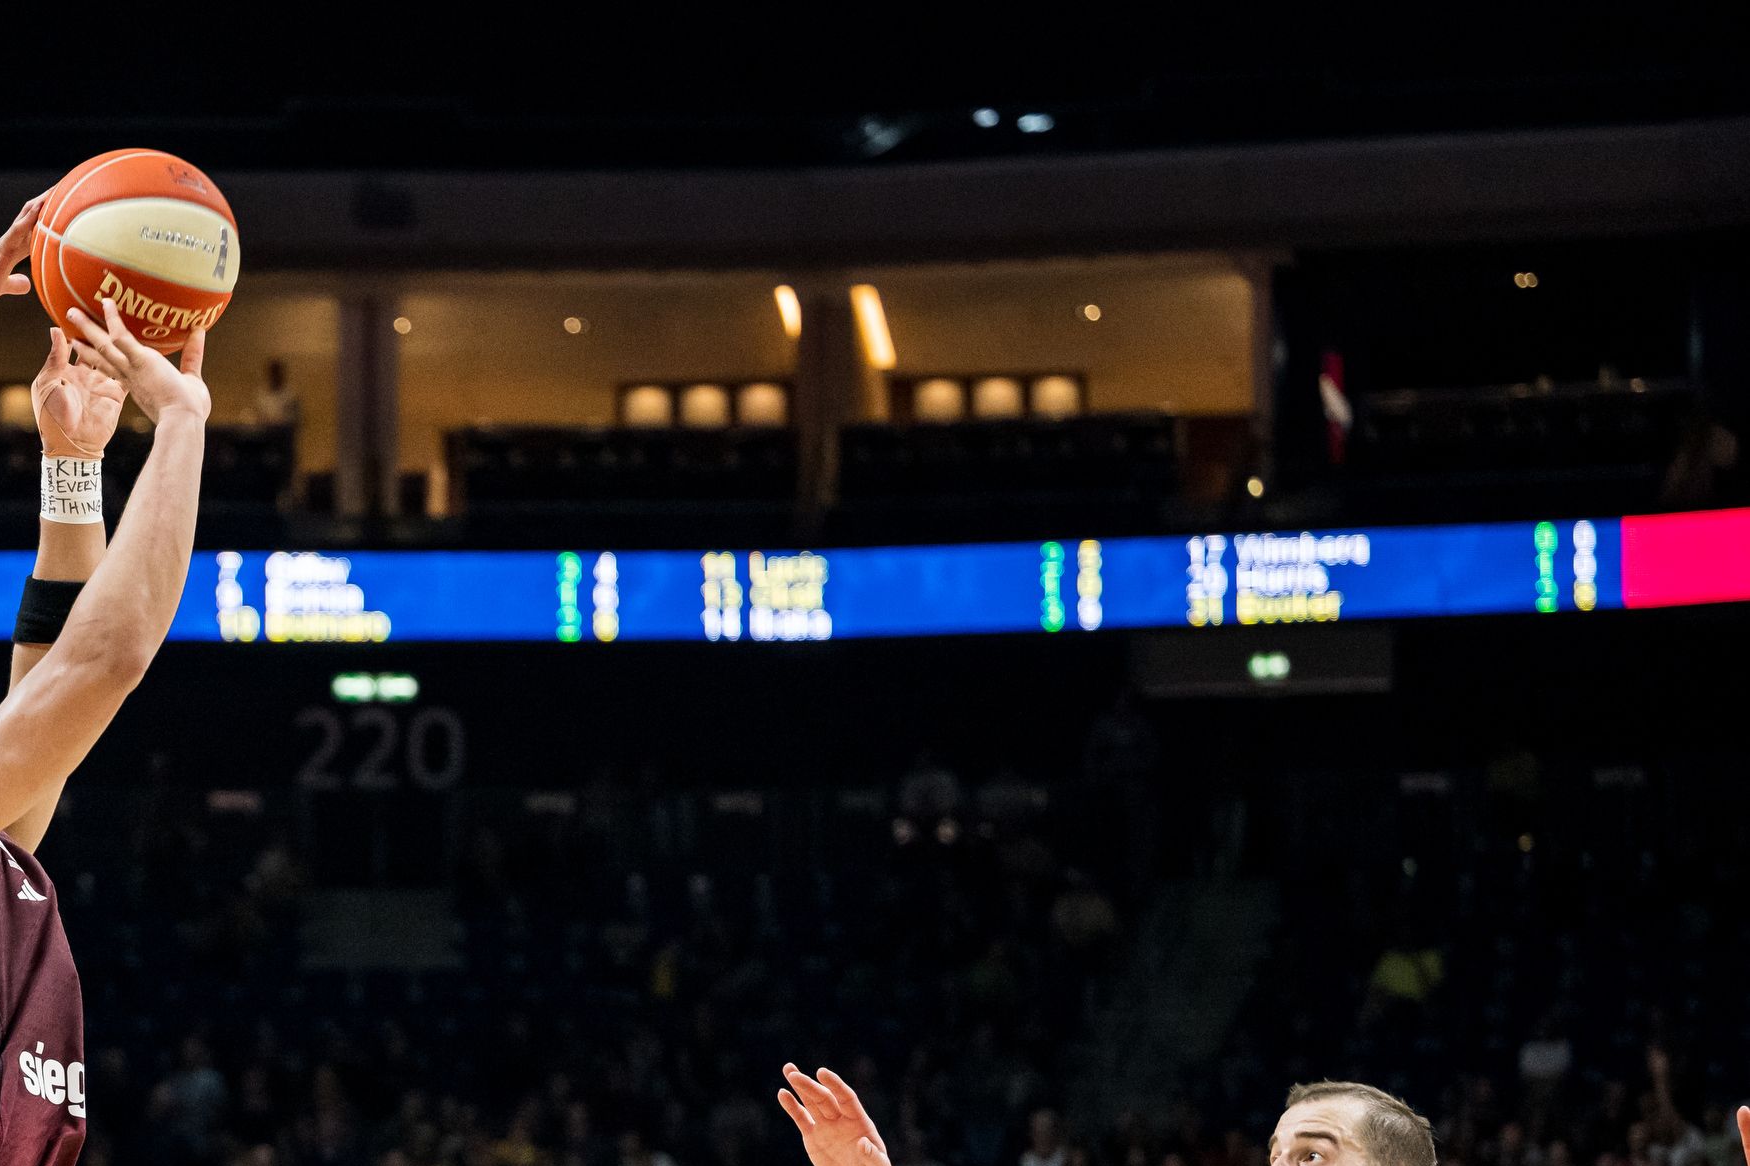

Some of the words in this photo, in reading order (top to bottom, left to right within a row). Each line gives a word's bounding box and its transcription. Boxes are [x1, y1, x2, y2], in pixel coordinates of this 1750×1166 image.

[94, 271, 224, 330] SPALDING
[56, 459, 100, 477] KILL
[56, 477, 98, 493] EVERY
[55, 497, 101, 515] THING
